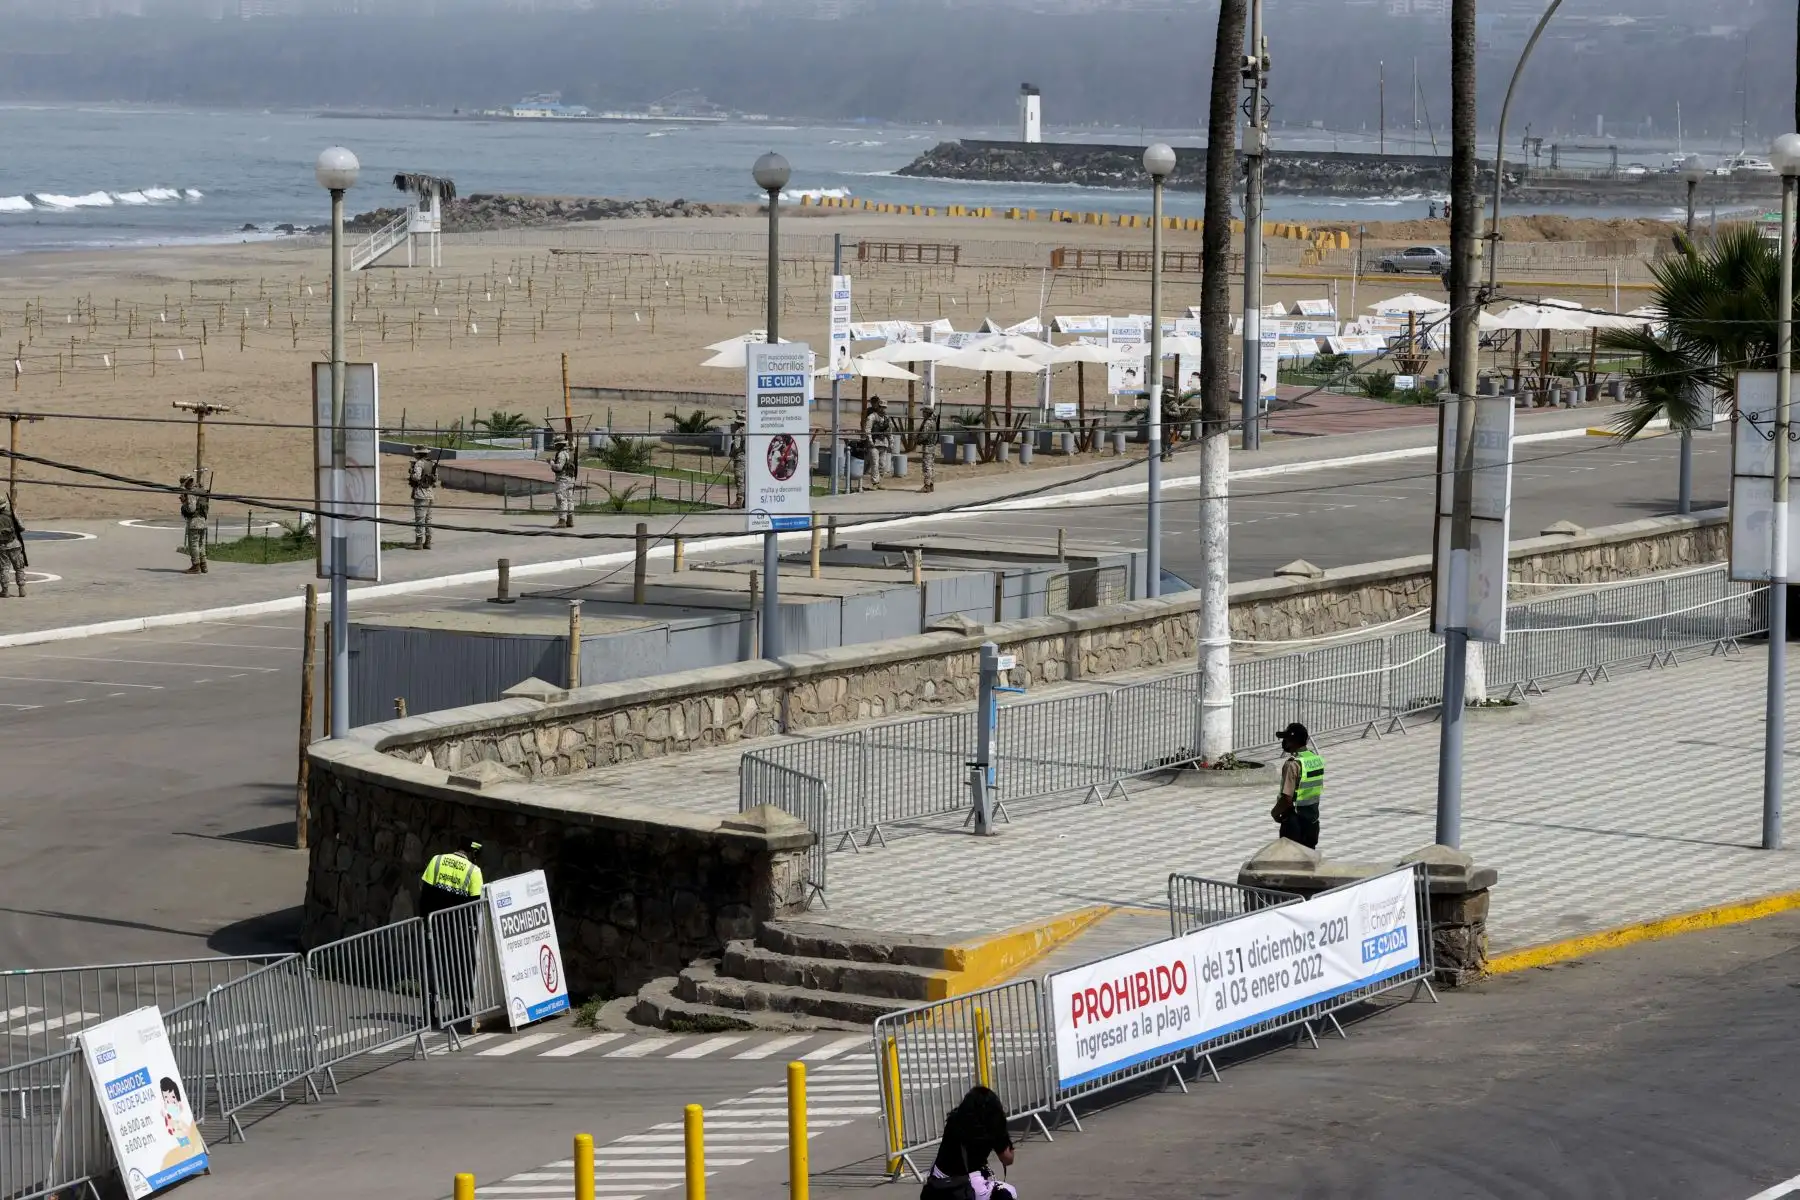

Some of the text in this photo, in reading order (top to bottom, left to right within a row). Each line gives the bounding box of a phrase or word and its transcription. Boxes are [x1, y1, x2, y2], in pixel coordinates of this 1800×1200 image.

[768, 361, 804, 371] Chorrillos
[760, 376, 802, 387] TE CUIDA
[760, 395, 801, 405] PROHIBIDO
[760, 486, 774, 494] multa
[501, 906, 548, 936] PROHIBIDO
[1202, 916, 1349, 983] del 31 diciembre 2021
[1363, 929, 1406, 960] TE CUIDA
[1072, 960, 1187, 1029] PROHIBIDO
[1215, 953, 1324, 1012] al 03 enero 2022
[1075, 1004, 1190, 1060] ingresar a la playa
[105, 1072, 146, 1099] HORARIO DE
[113, 1088, 156, 1115] USO DE PLAYA
[120, 1125, 128, 1136] de
